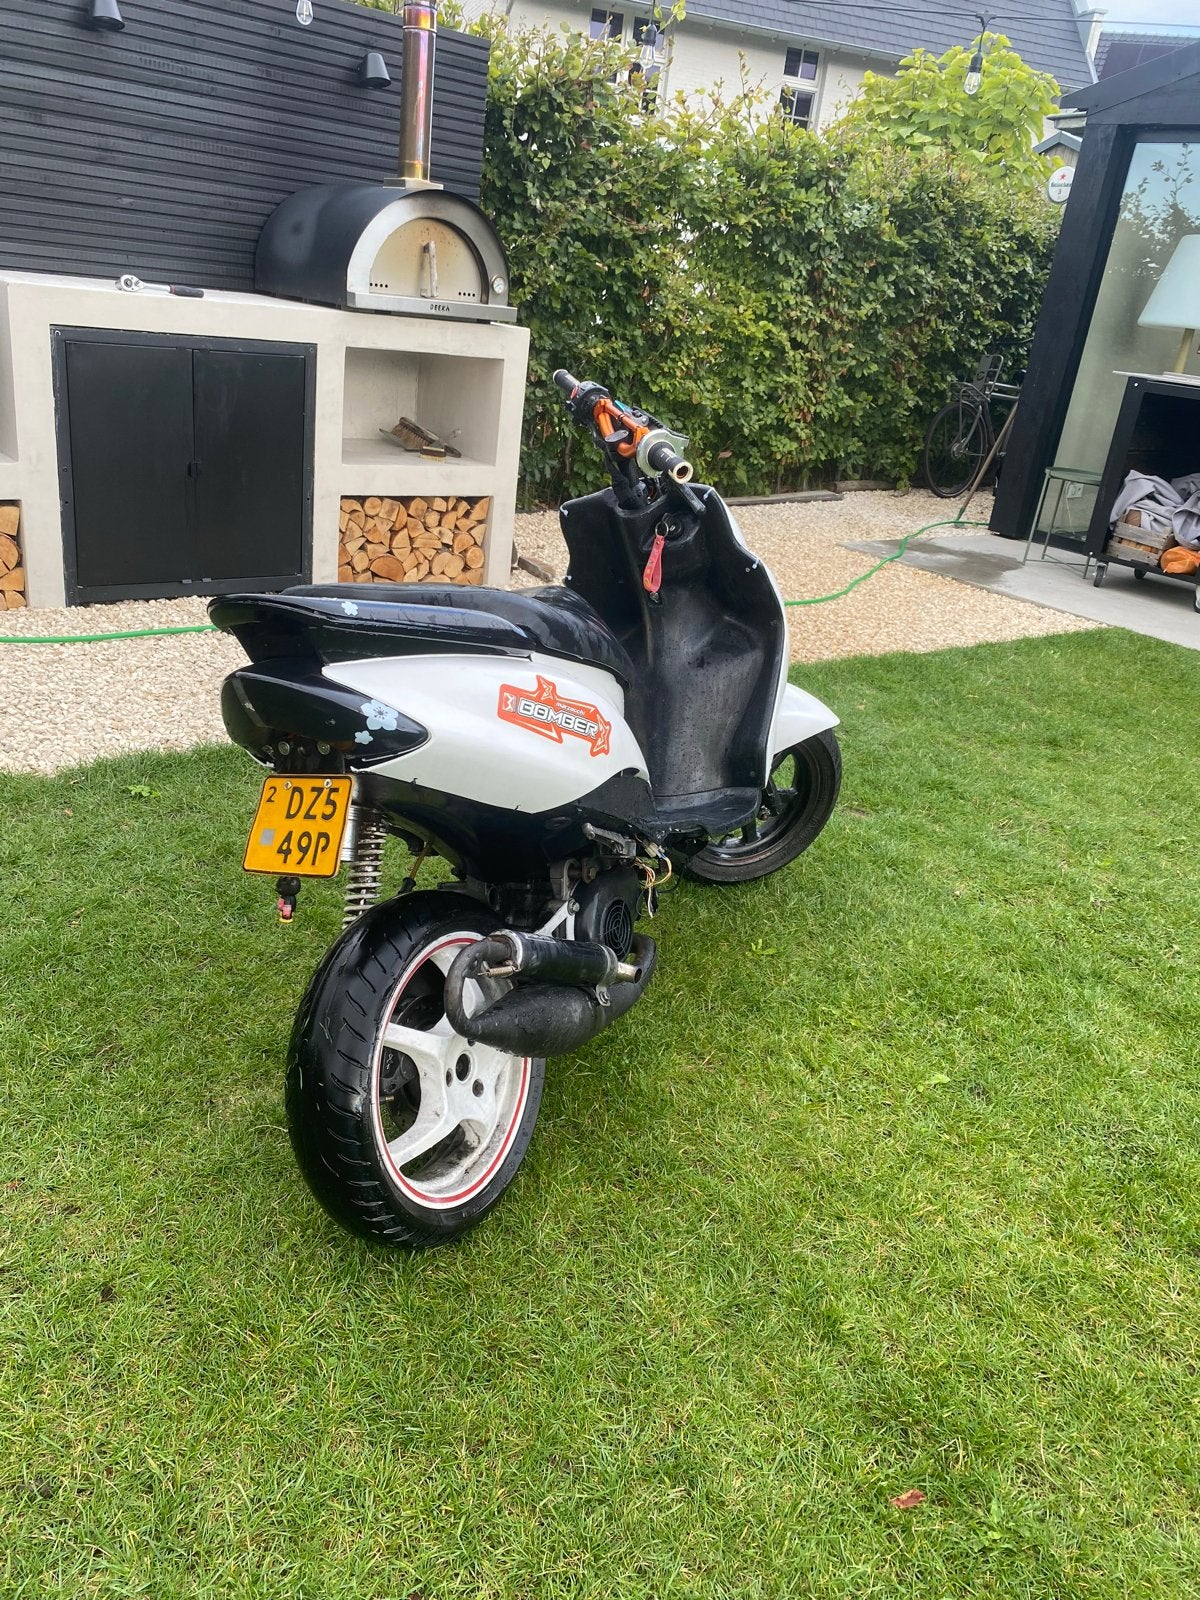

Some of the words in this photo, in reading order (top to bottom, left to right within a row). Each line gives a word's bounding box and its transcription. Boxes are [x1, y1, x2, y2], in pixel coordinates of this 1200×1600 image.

[518, 698, 600, 739] BOMBER
[266, 786, 278, 803] 2
[285, 786, 340, 821] DZ5
[276, 830, 331, 866] 49P
